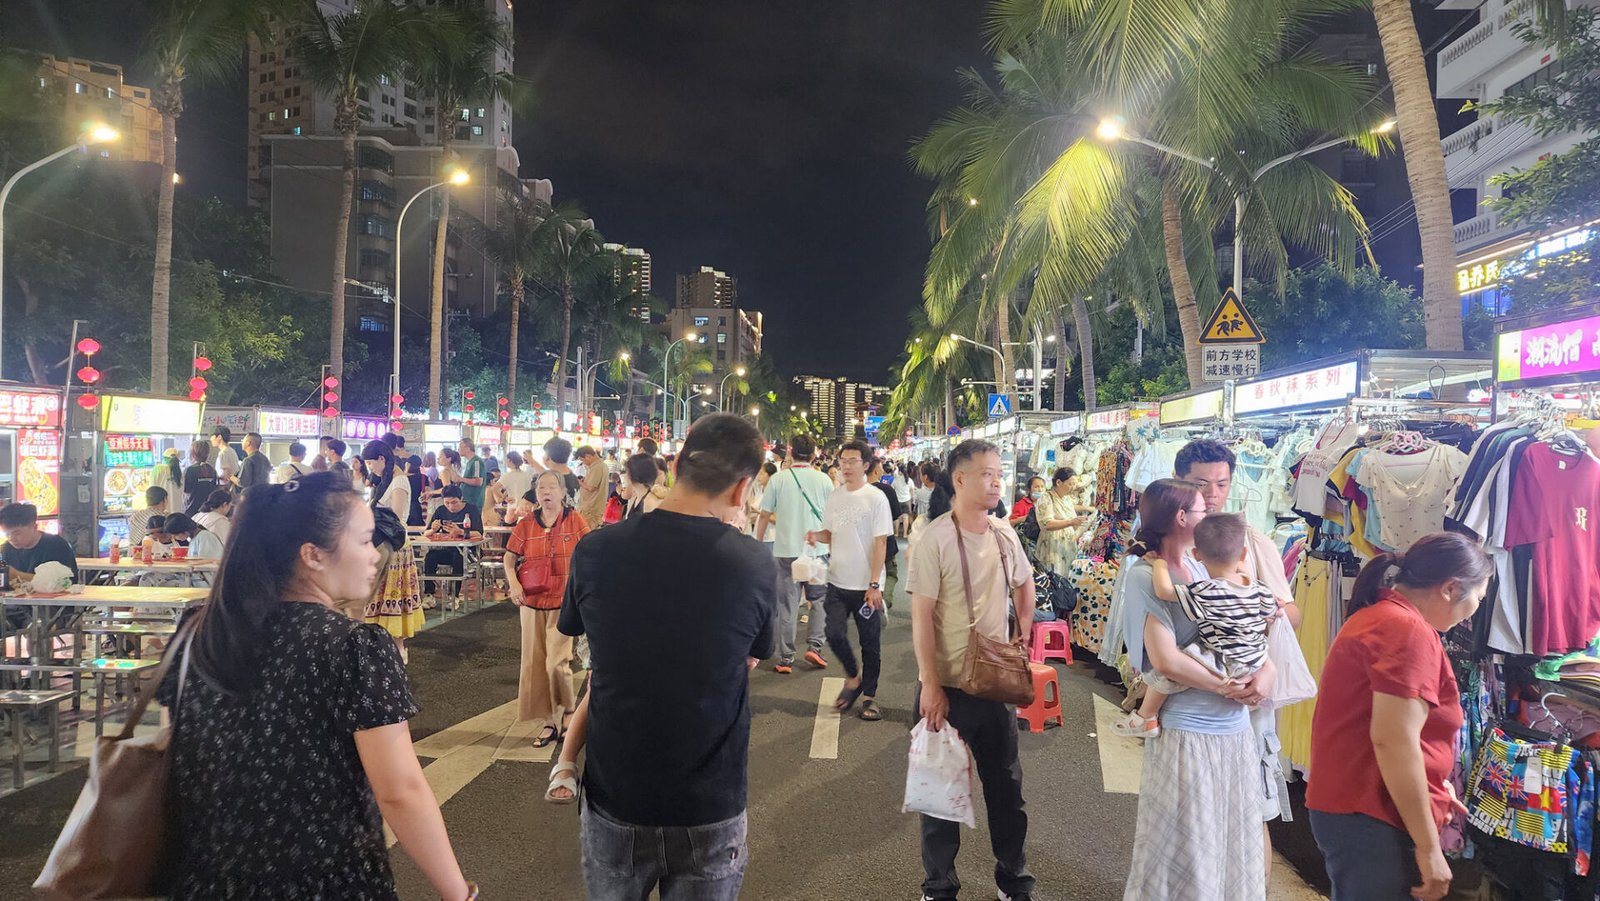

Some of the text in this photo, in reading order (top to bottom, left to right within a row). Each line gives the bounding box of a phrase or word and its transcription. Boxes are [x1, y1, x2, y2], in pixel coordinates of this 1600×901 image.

[1206, 349, 1257, 361] 前方学校
[1206, 364, 1257, 376] 减速慢行
